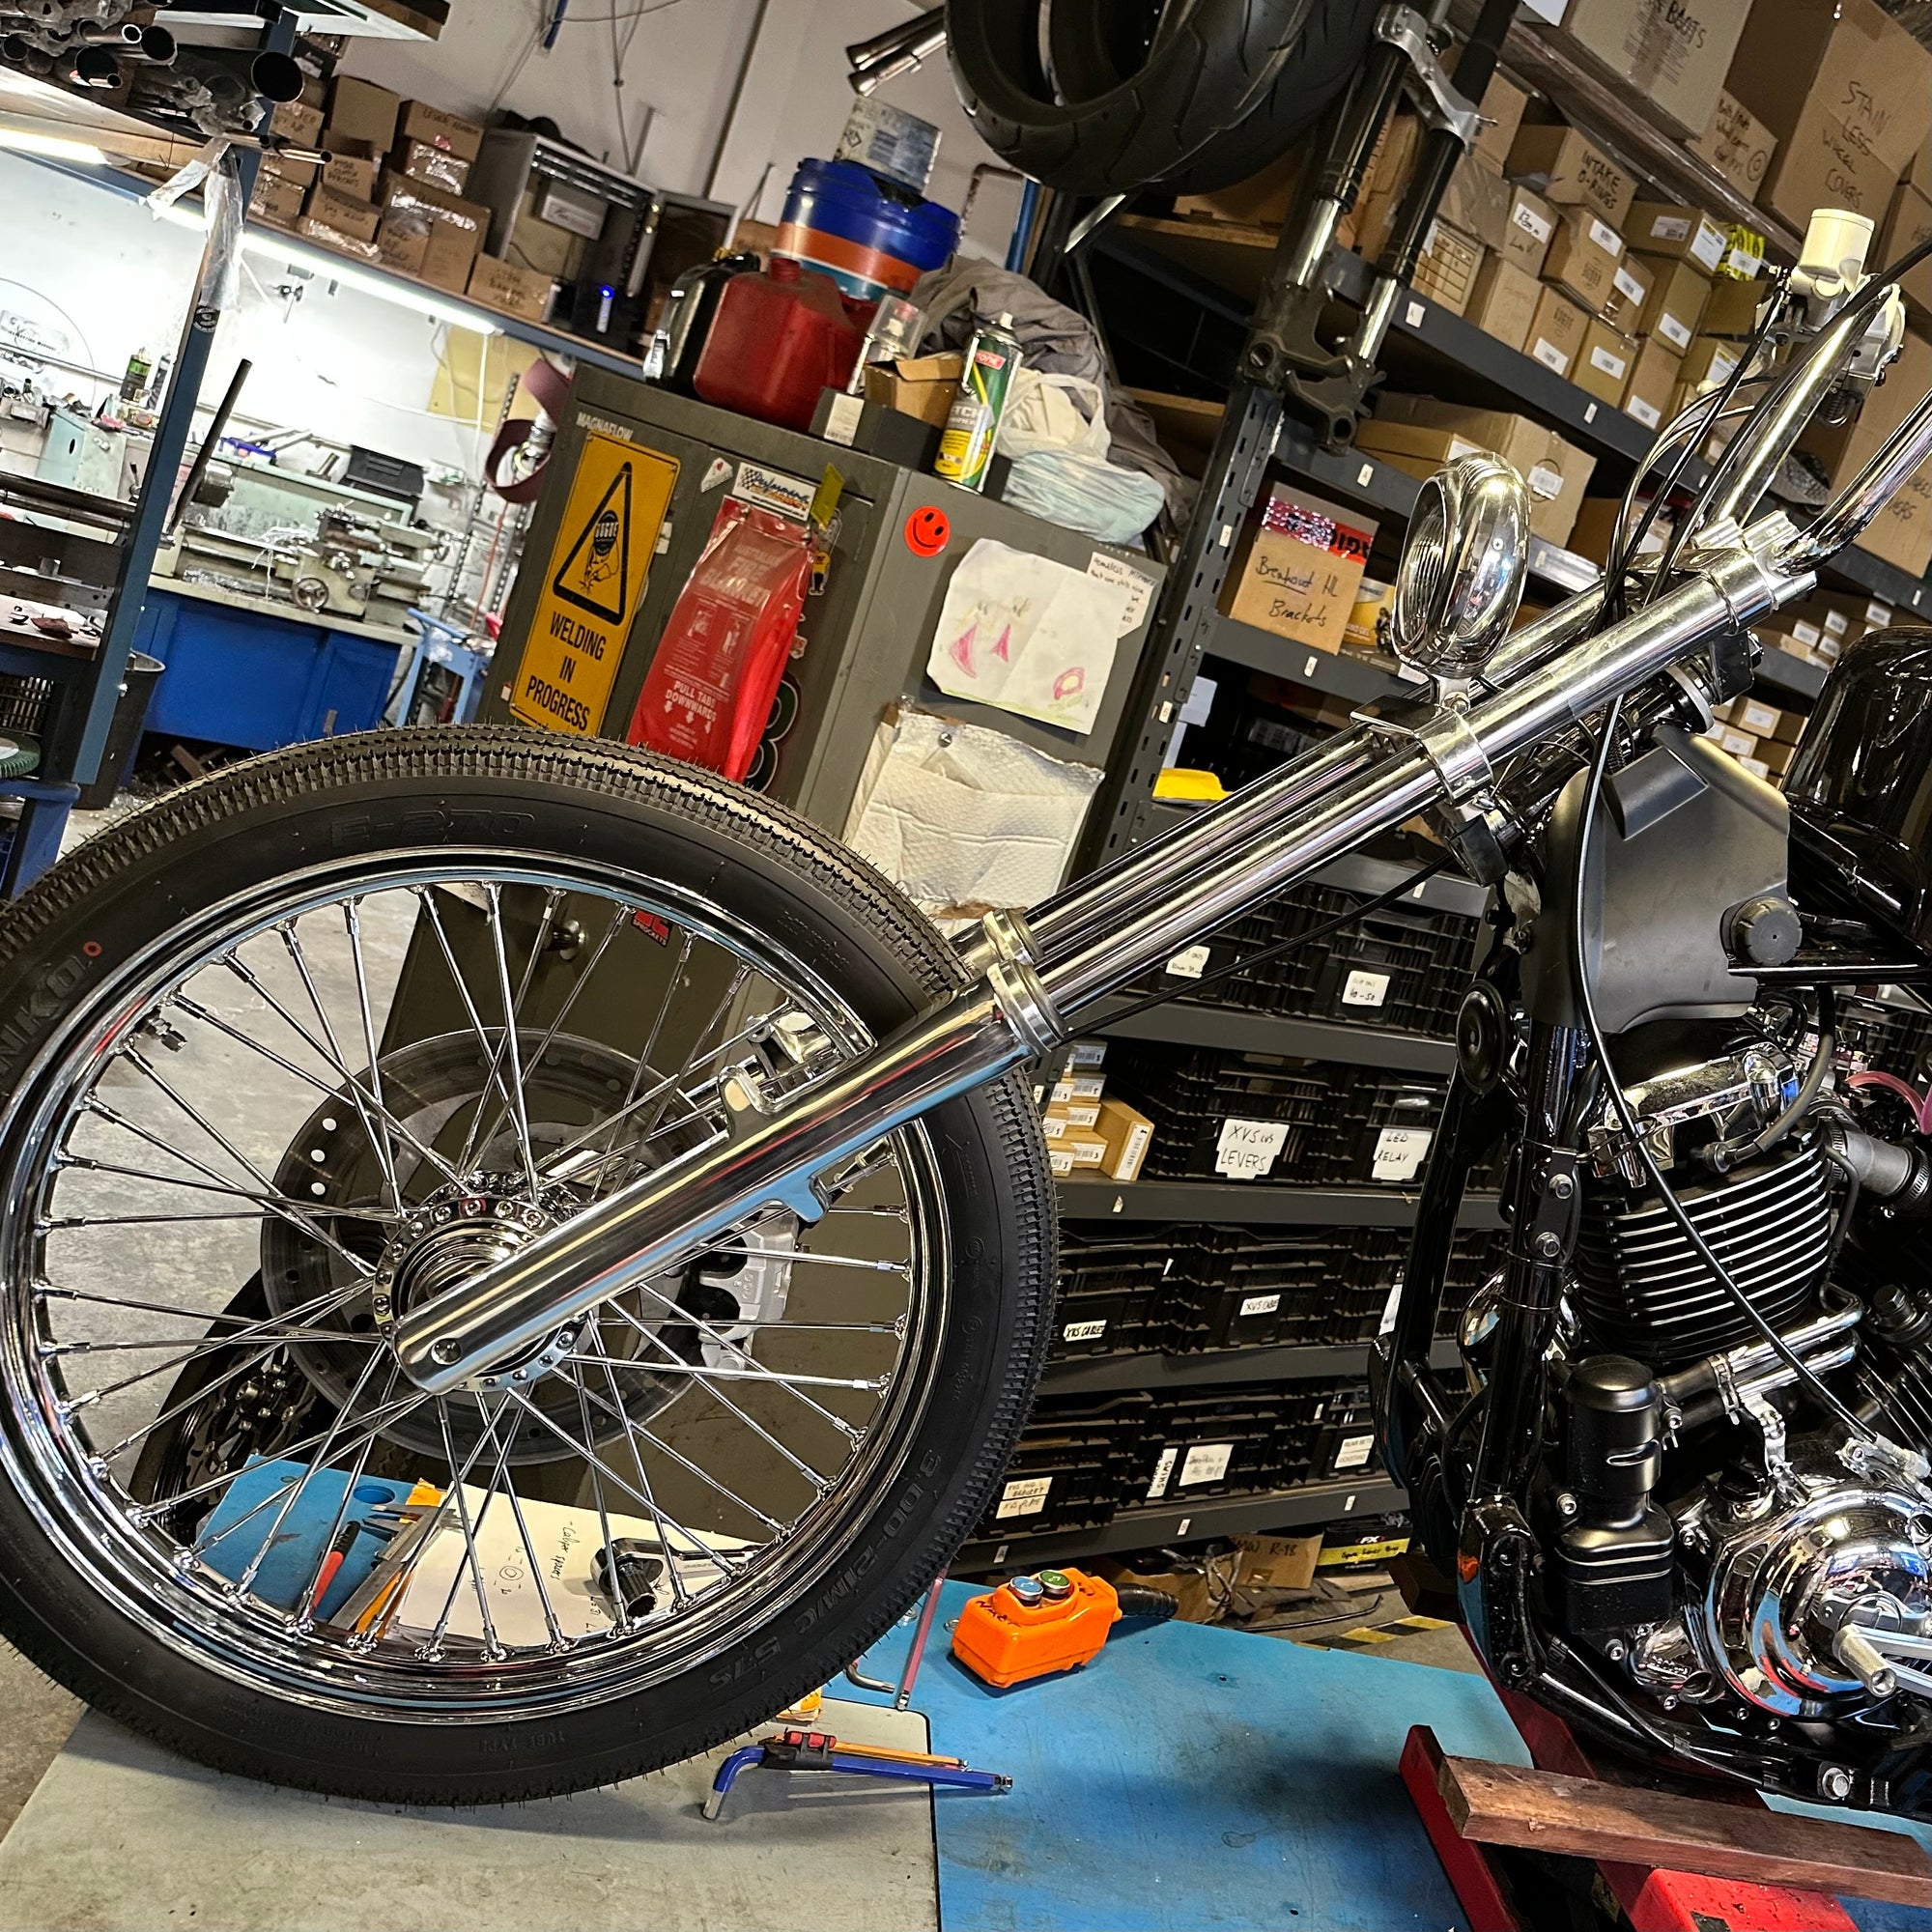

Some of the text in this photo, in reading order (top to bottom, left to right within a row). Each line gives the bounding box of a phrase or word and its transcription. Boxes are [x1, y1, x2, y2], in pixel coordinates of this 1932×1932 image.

[1841, 80, 1893, 137] STAIN
[1841, 115, 1874, 157] LESS
[1581, 150, 1621, 190] INTAKE
[576, 412, 634, 442] MAGNAFLOW
[727, 556, 771, 582] FIRE
[1255, 555, 1315, 589] Breakout
[699, 568, 771, 609] BLANKET
[549, 611, 607, 662] WELDING
[558, 656, 577, 684] IN
[526, 675, 591, 732] PROGRESS
[665, 689, 717, 724] DOWNWARDS
[673, 681, 718, 710] PULL TABS
[331, 810, 535, 849] E-270
[632, 919, 668, 947] SPROCKETS
[1227, 1124, 1261, 1144] XVS
[1385, 1131, 1409, 1143] LED
[1220, 1148, 1267, 1173] LEVERS
[1377, 1149, 1410, 1163] RELAY
